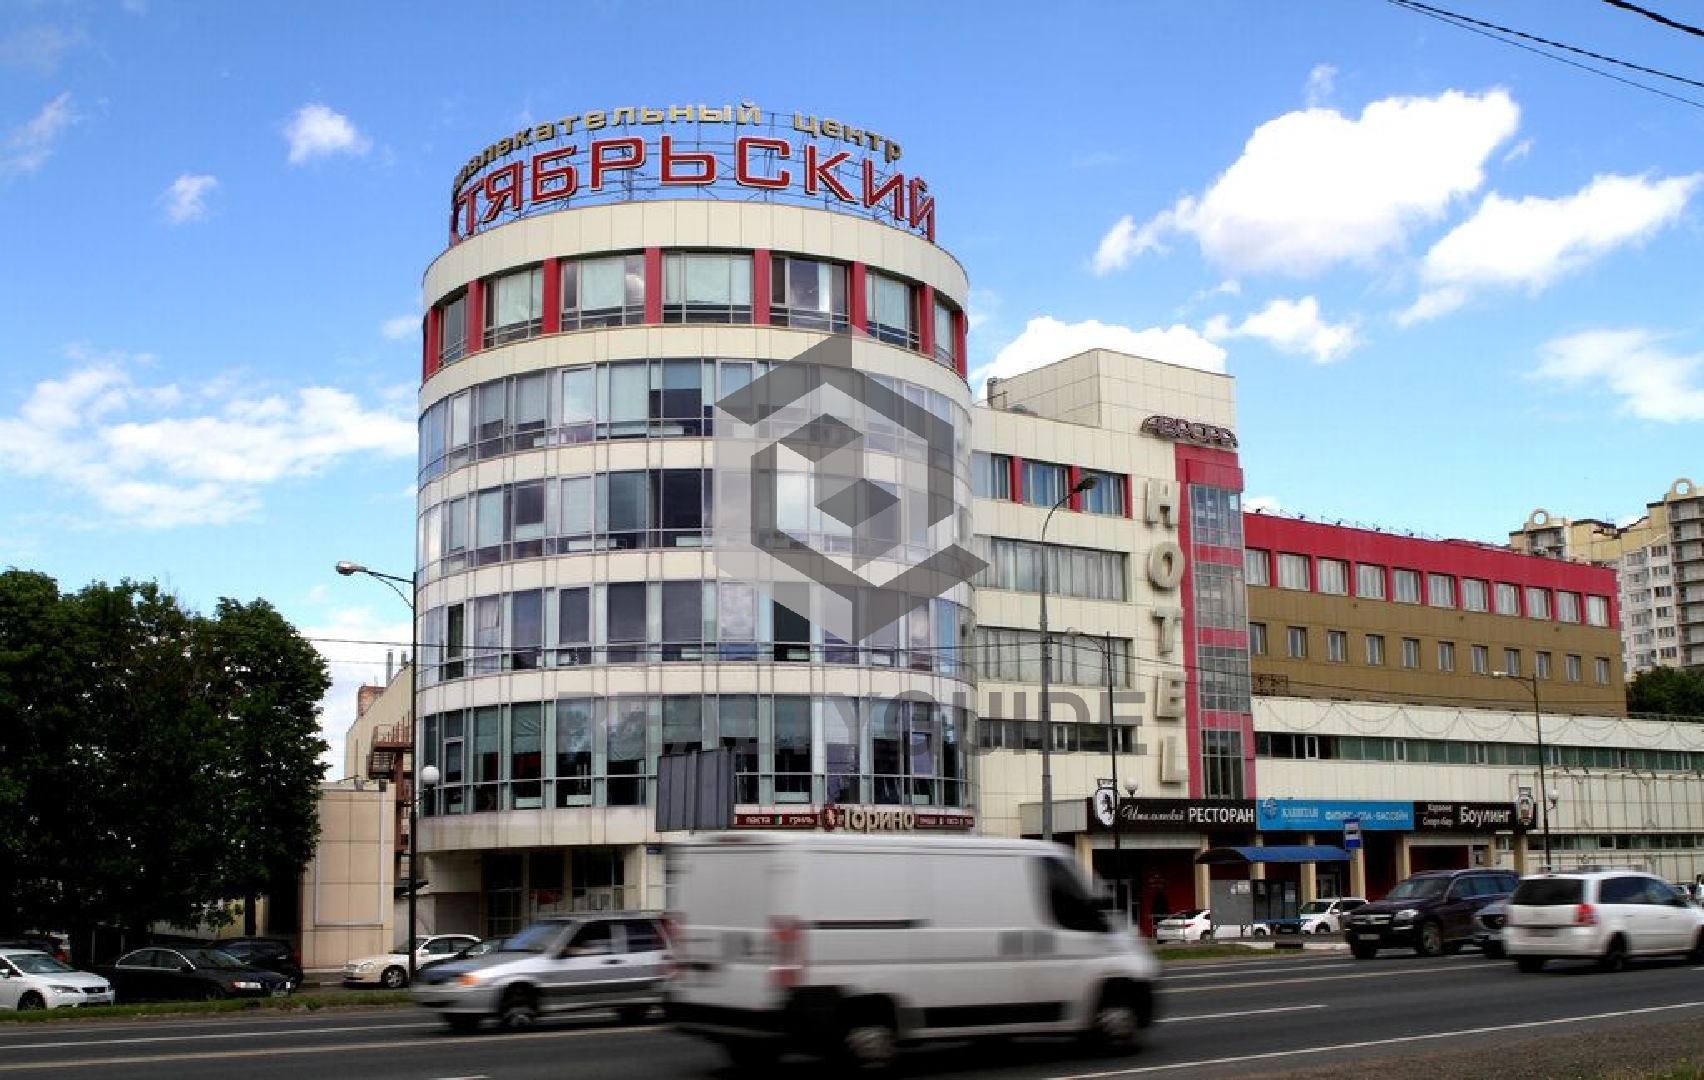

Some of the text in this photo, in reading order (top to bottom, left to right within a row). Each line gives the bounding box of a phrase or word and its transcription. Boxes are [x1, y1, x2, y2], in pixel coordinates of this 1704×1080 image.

[793, 109, 903, 163] центр
[1145, 478, 1187, 785] HOTEL
[843, 808, 914, 833] Торино
[1189, 808, 1255, 823] РЕСТОРАН
[1460, 806, 1512, 827] Боулинг
